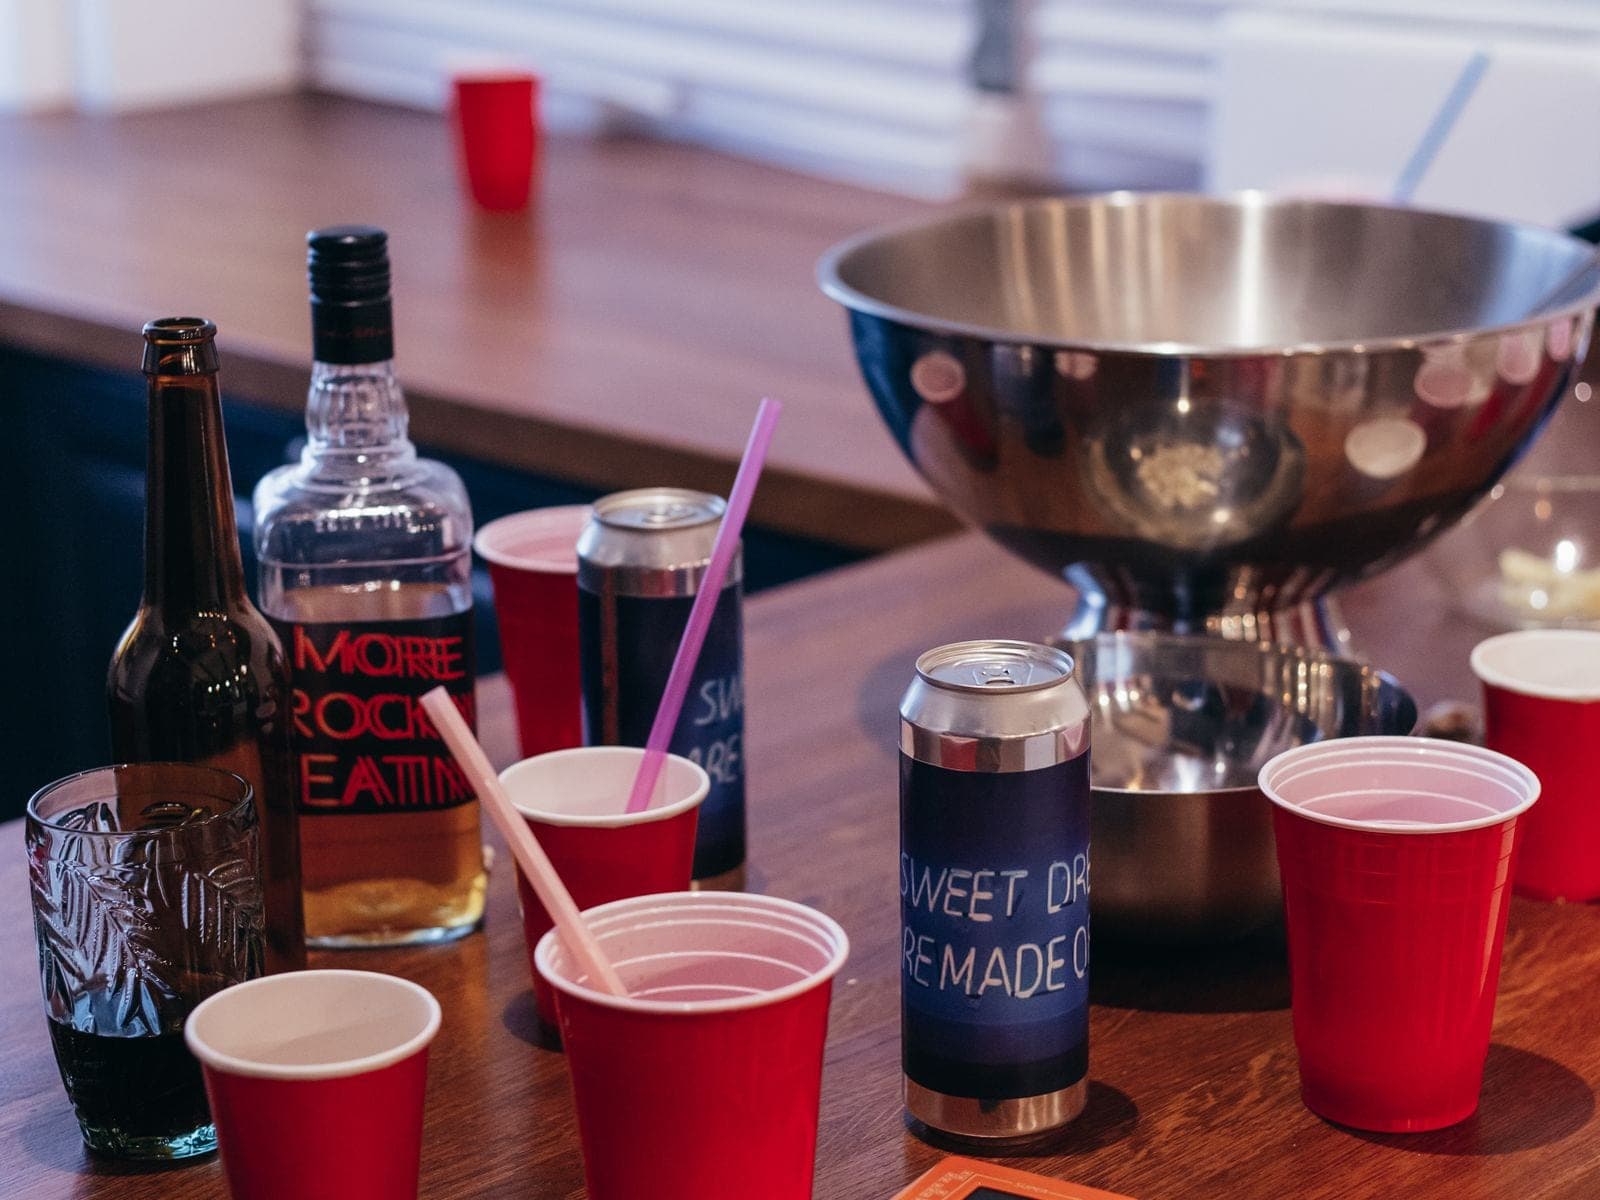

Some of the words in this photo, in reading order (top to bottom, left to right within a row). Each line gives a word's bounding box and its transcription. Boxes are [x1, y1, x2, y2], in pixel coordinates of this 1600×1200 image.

[294, 624, 465, 680] MORE
[901, 852, 1028, 922] SWEET
[939, 934, 1066, 999] MADE
